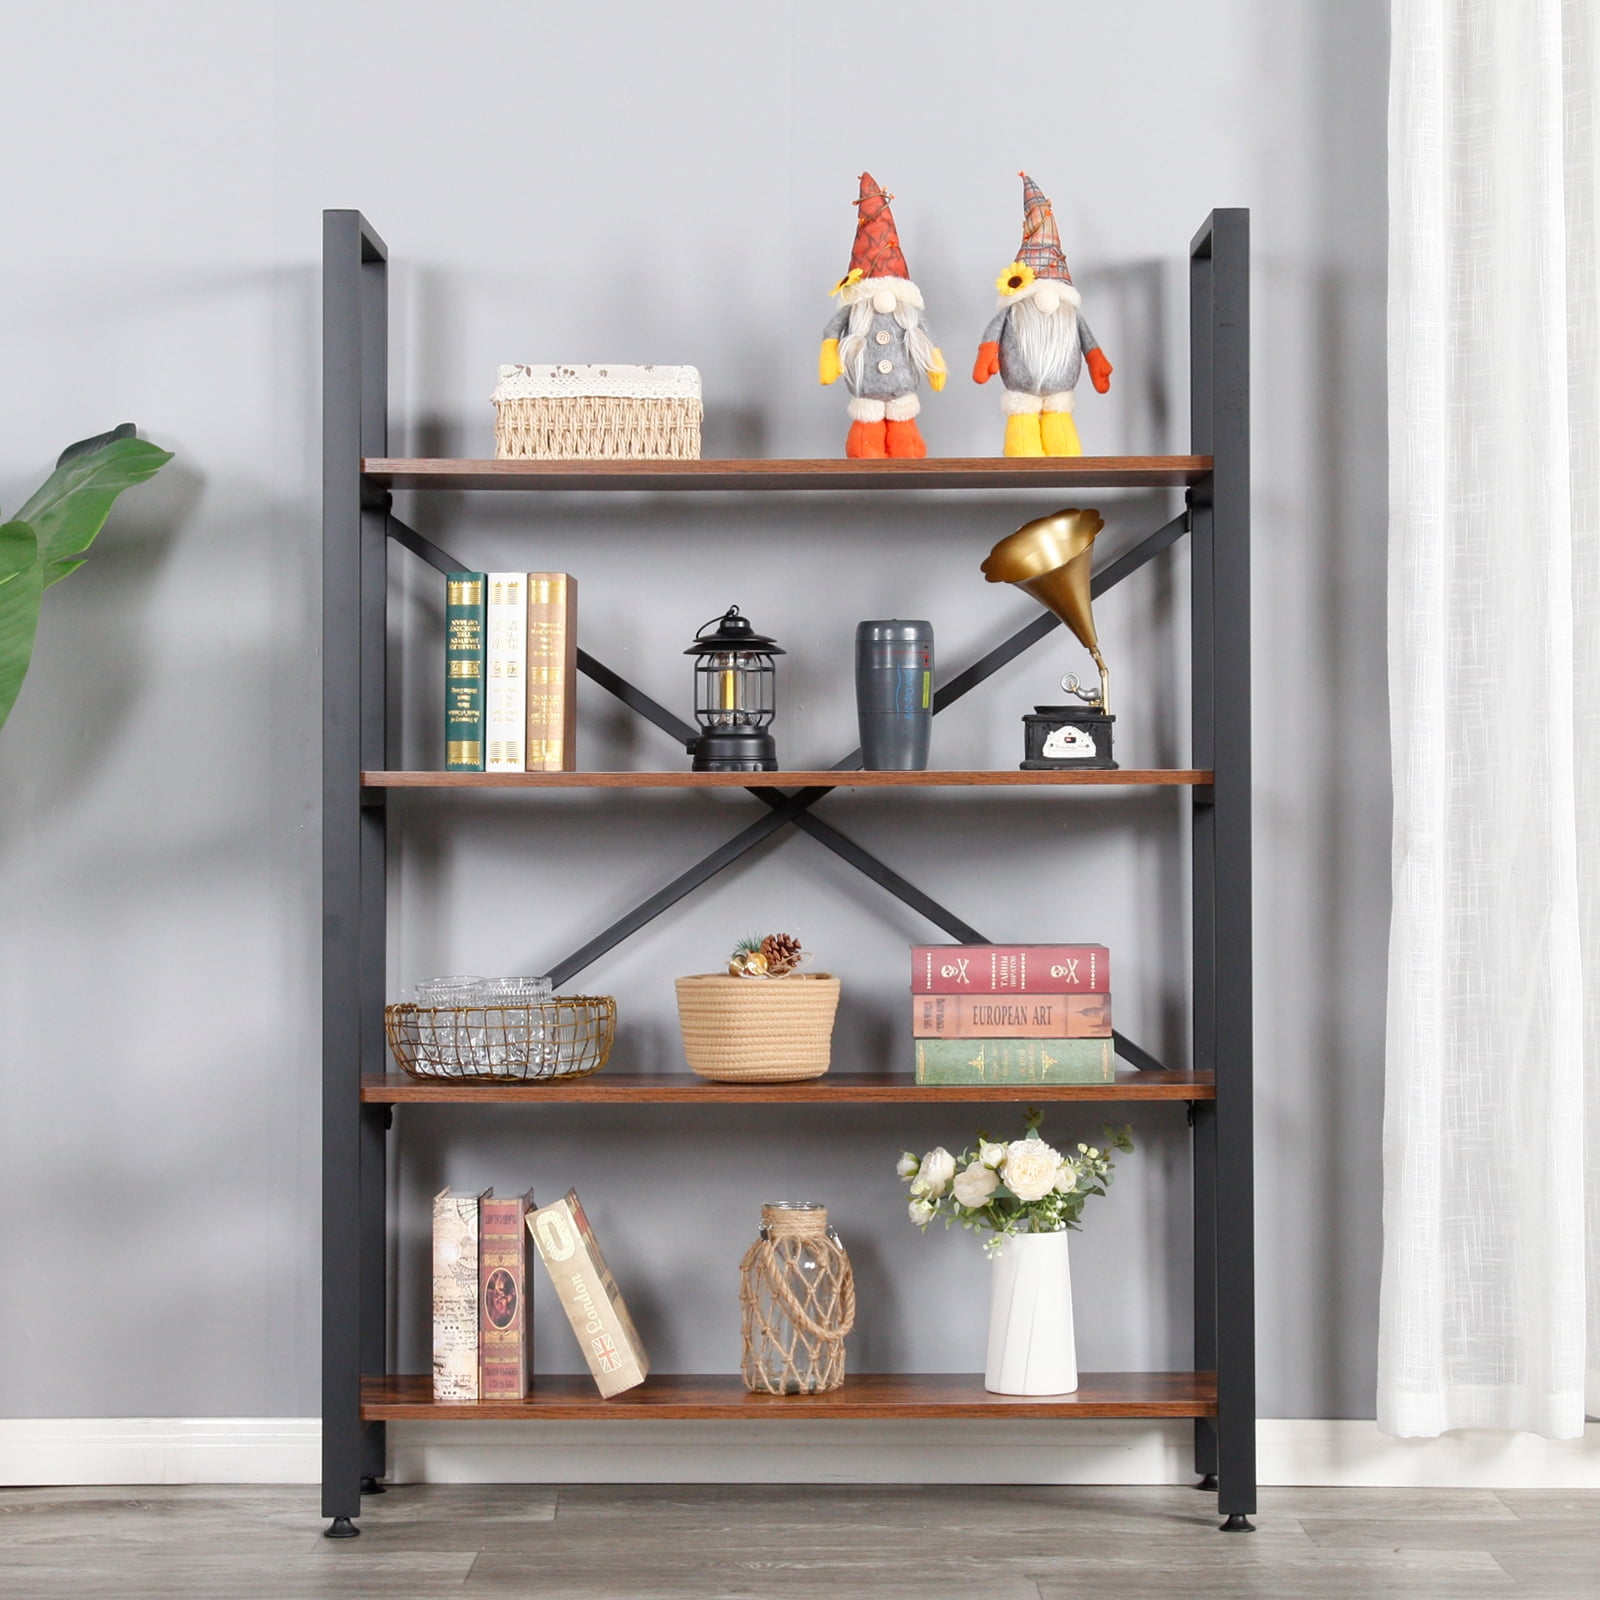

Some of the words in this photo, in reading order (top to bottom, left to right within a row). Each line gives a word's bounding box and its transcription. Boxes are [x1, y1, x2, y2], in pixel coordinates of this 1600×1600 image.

[1000, 955, 1009, 987] ТАЙНЫ
[972, 1005, 1028, 1026] EUROPEAN
[1032, 1005, 1053, 1026] ART
[571, 1272, 604, 1334] London
